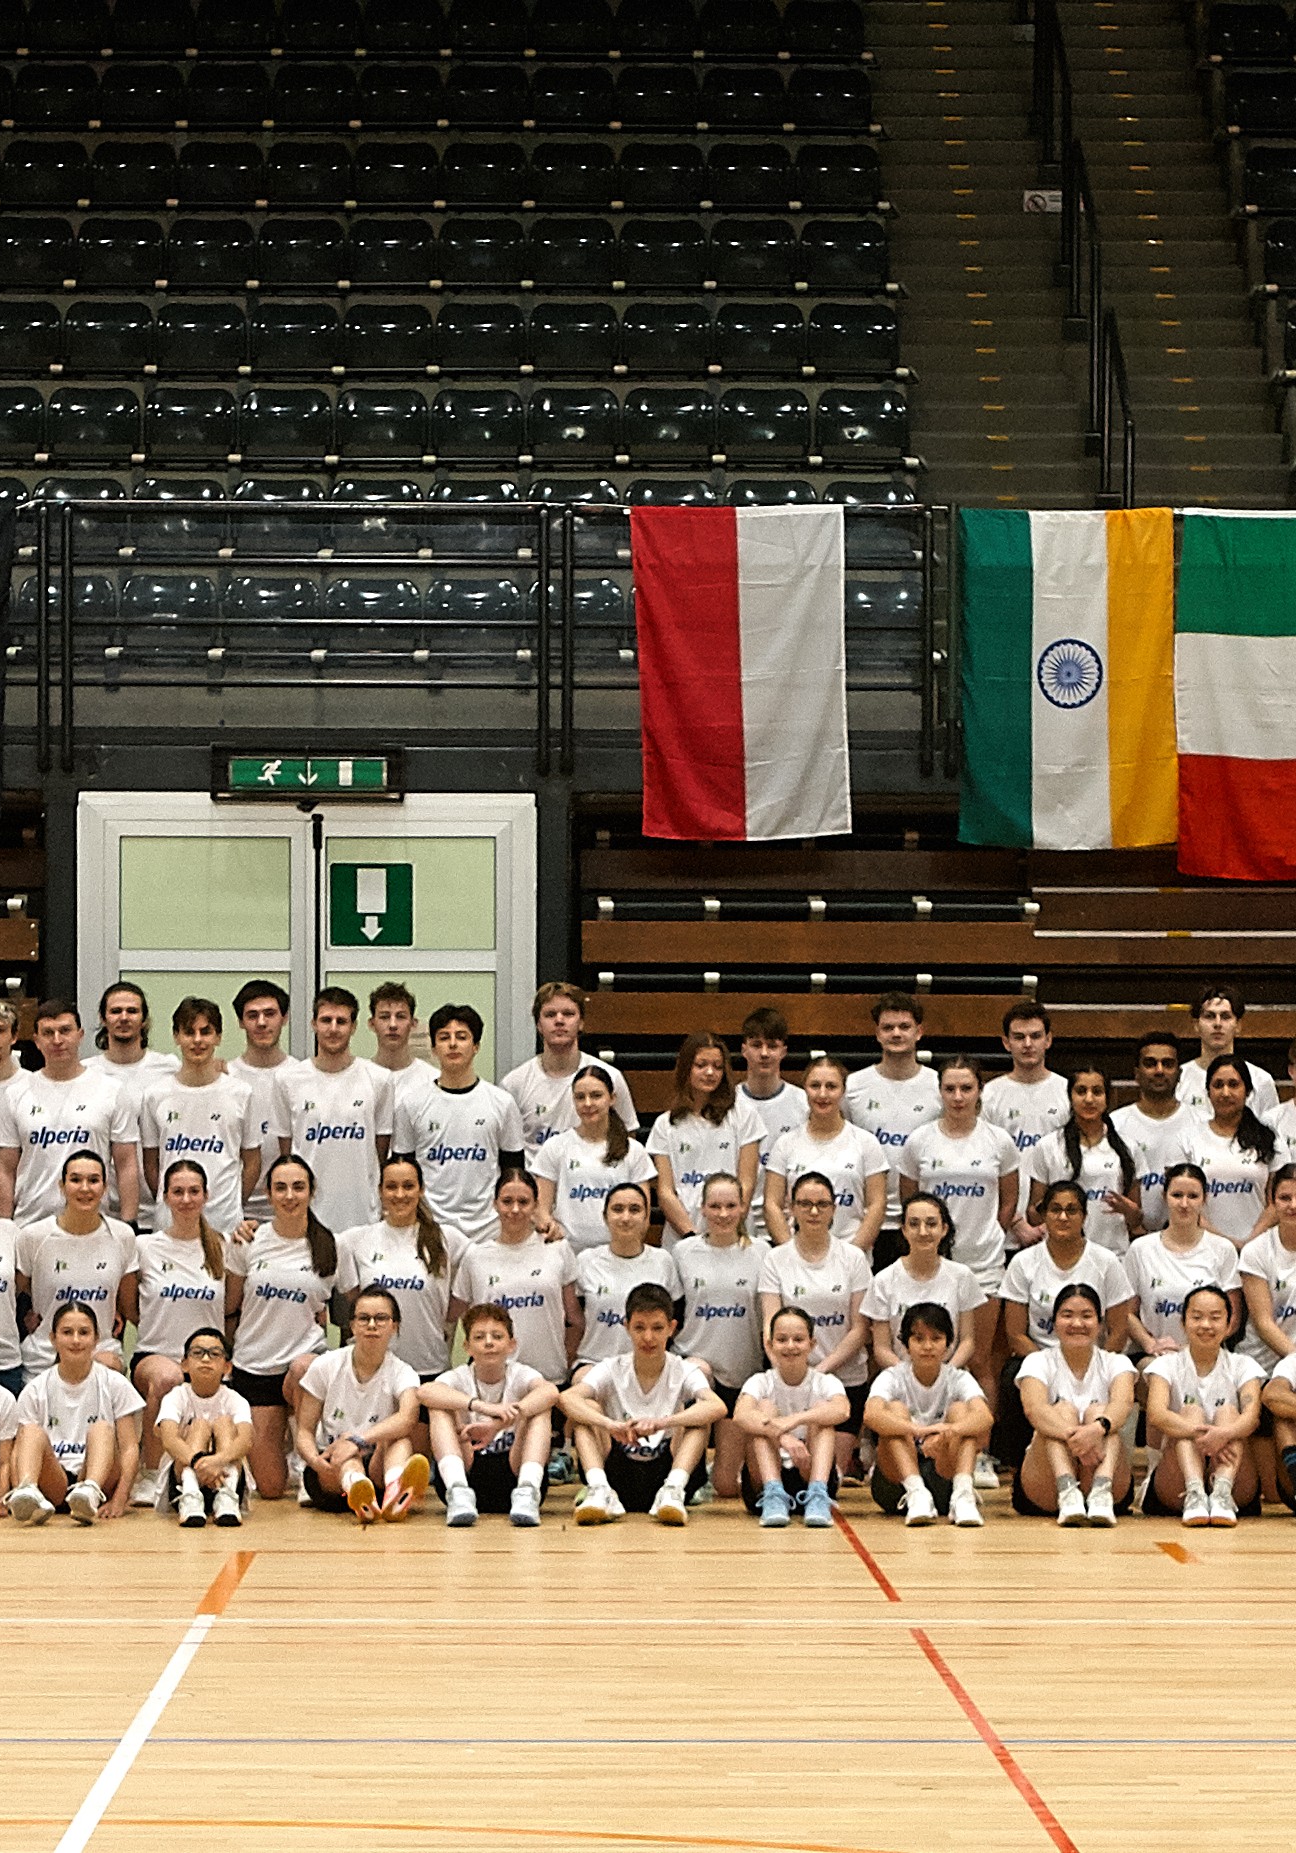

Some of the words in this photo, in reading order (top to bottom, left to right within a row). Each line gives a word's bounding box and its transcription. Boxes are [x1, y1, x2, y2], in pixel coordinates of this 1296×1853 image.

[29, 1126, 89, 1149] alperia
[306, 1122, 365, 1144] alperia
[165, 1133, 224, 1155] alperia
[427, 1143, 486, 1165] alperia
[934, 1182, 985, 1198] alperia
[56, 1286, 107, 1303] alperia
[160, 1284, 215, 1302] alperia
[255, 1283, 306, 1304] alperia
[696, 1304, 746, 1321] alperia
